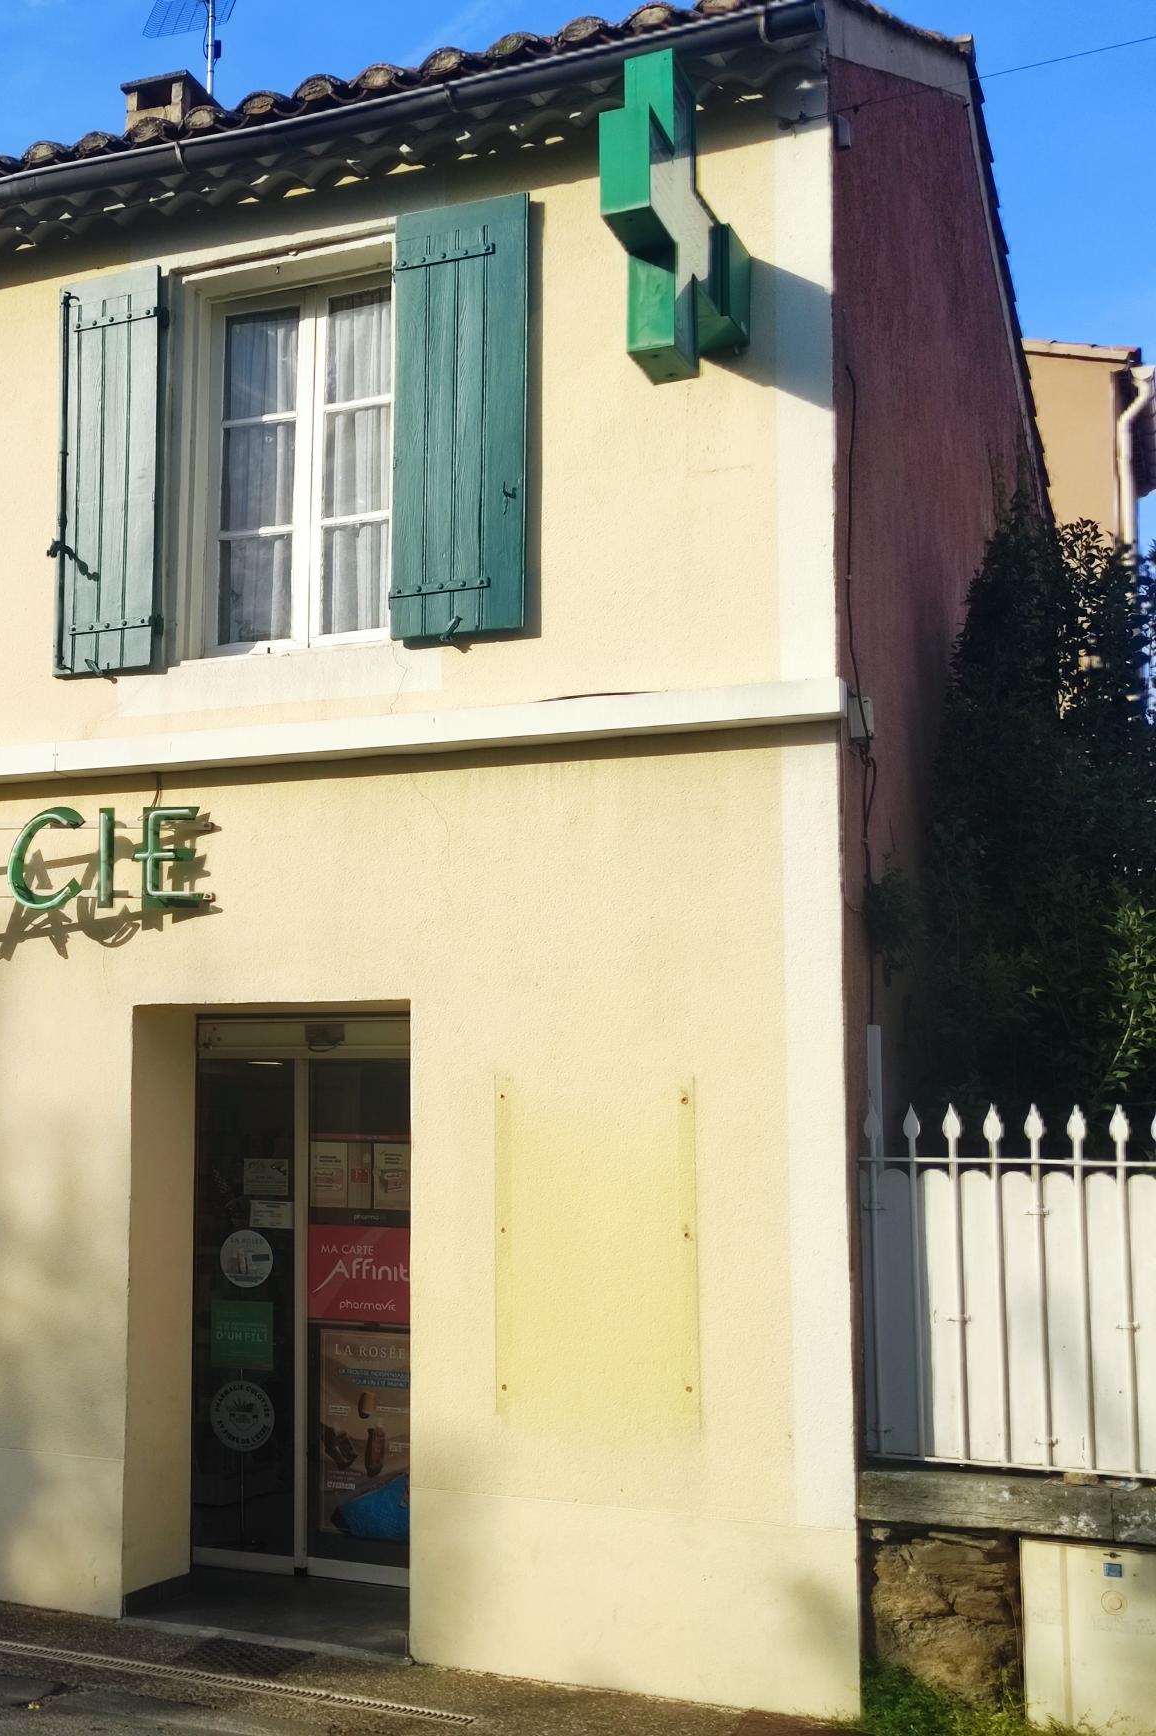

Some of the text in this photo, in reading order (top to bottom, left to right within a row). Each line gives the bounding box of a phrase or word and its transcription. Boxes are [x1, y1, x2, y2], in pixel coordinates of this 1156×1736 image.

[321, 1244, 374, 1256] MA CARTE
[312, 1257, 410, 1294] Affinit
[335, 1343, 406, 1360] LA ROSÉE
